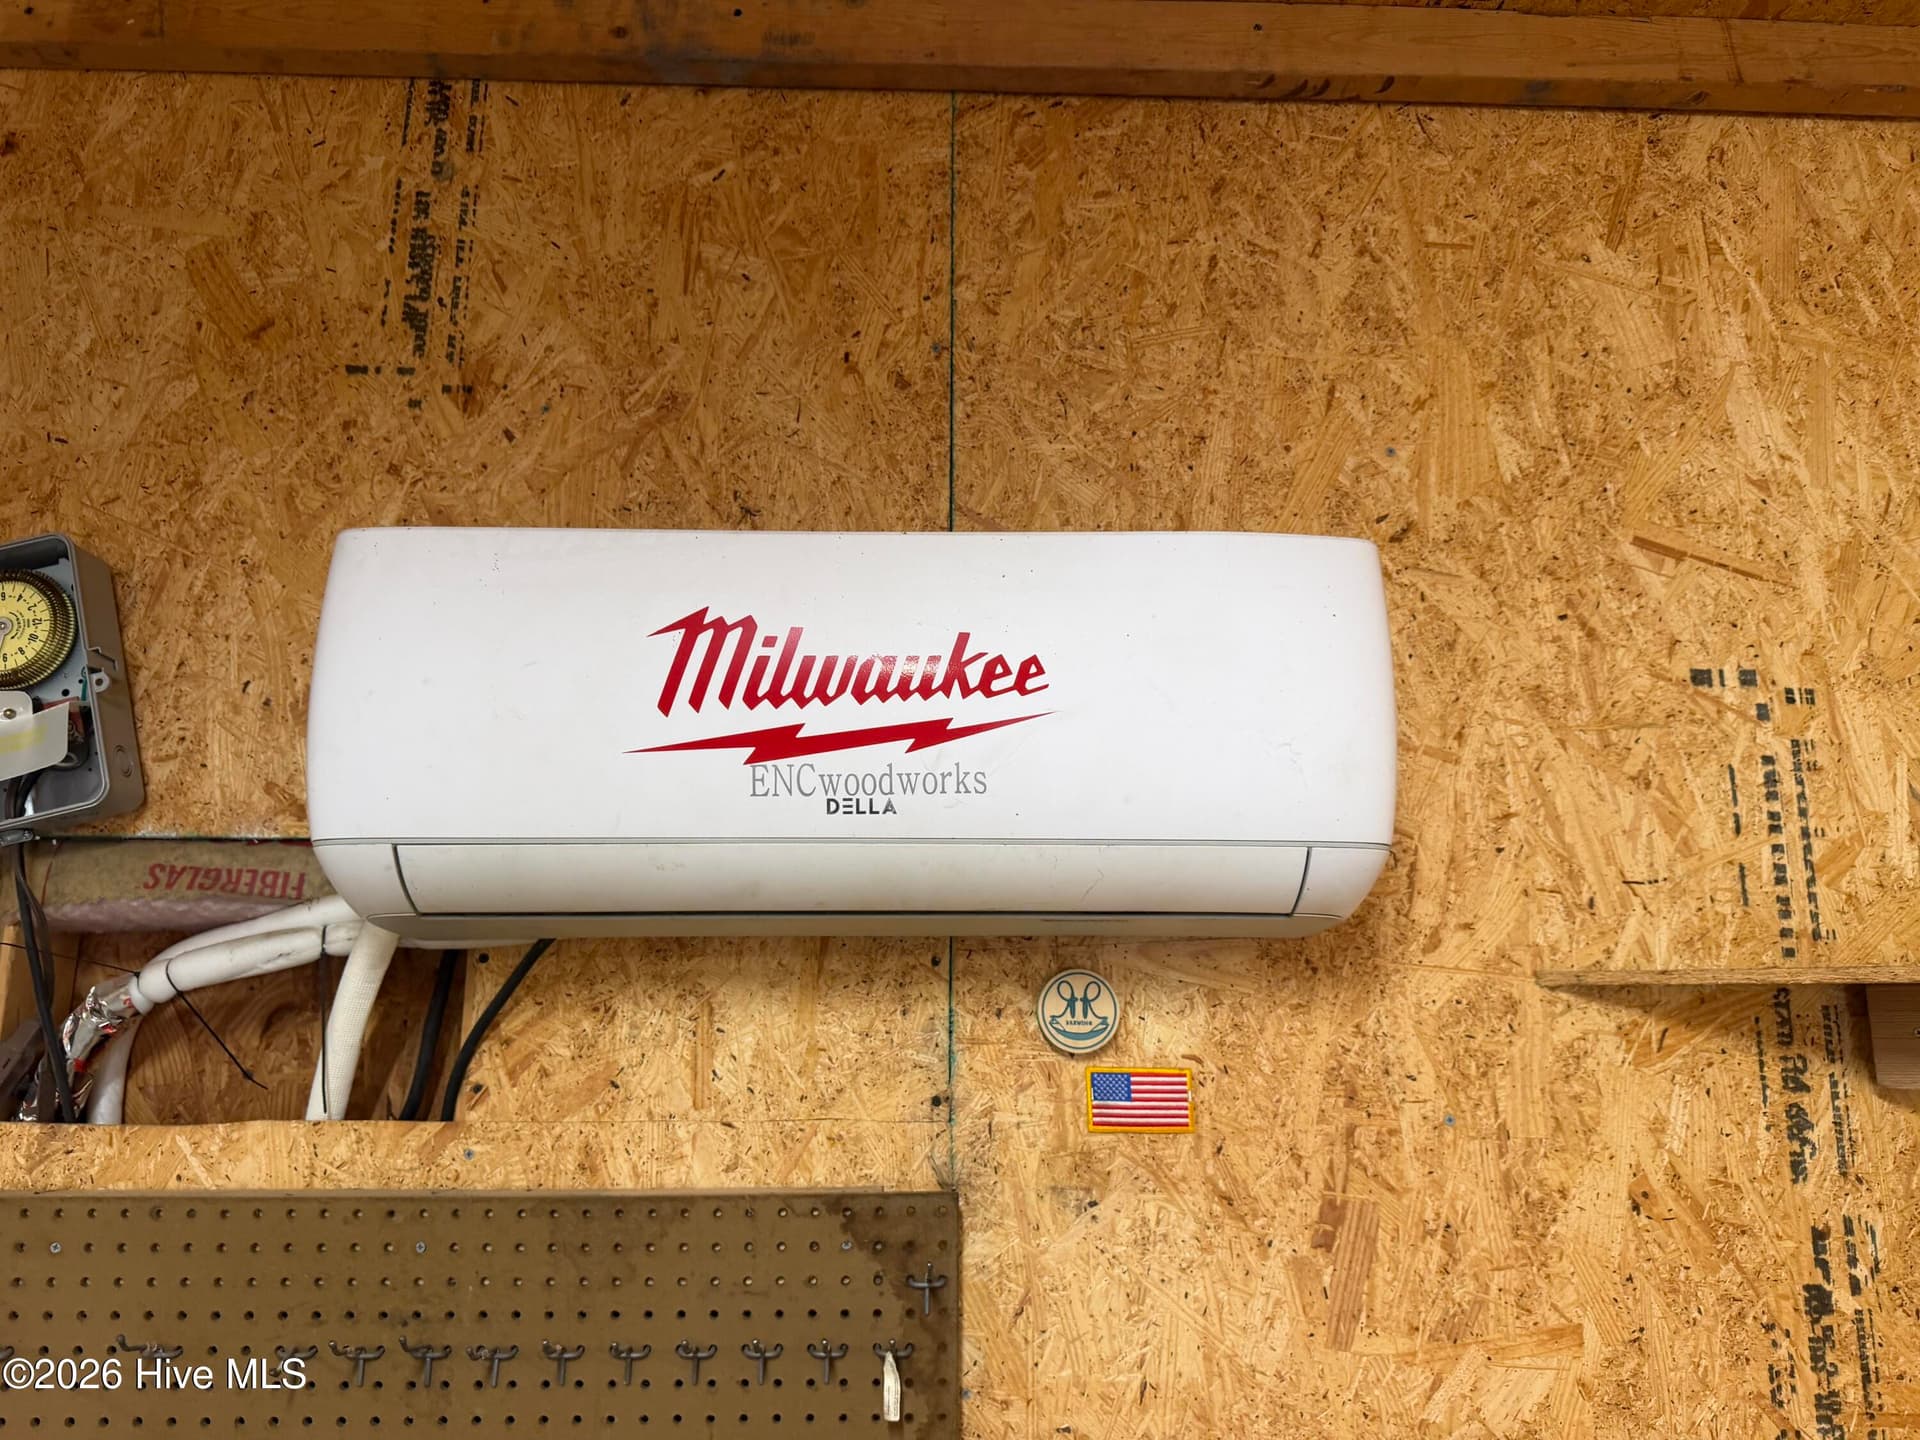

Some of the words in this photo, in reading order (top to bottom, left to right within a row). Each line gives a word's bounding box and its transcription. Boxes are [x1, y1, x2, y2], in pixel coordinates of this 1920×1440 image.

[27, 603, 37, 611] 2
[32, 617, 42, 626] 12
[28, 633, 39, 643] 10
[18, 646, 26, 655] 8
[2, 653, 8, 662] 6
[646, 605, 1050, 718] Milwaukee
[750, 761, 988, 798] ENCwoodworks
[826, 799, 897, 815] DELLA
